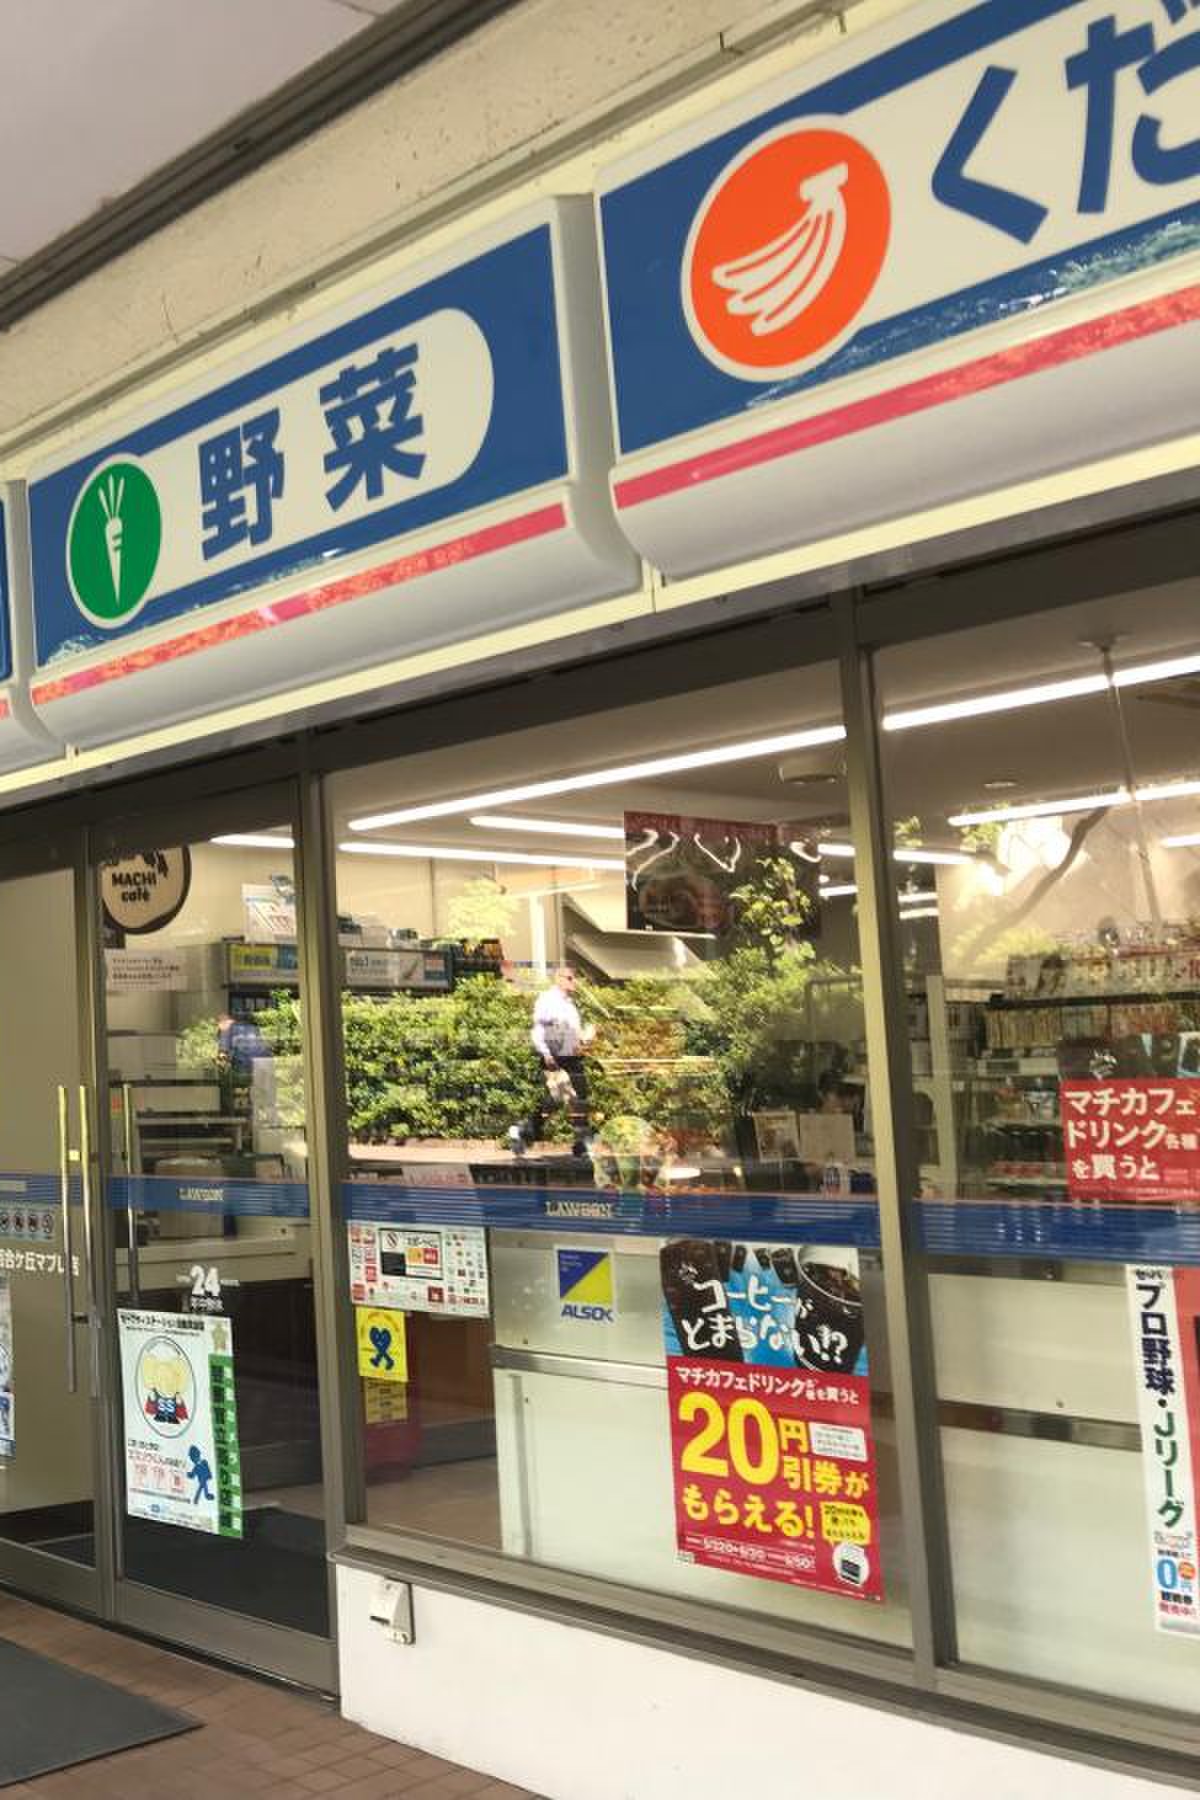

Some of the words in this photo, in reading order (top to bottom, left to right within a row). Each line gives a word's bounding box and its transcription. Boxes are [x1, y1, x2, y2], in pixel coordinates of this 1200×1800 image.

[198, 343, 426, 561] 野菜
[111, 872, 157, 887] MACHI
[1065, 1087, 1197, 1116] マチカフェ
[1071, 1154, 1161, 1180] を買うと
[544, 1201, 613, 1217] LAWSON
[190, 1265, 221, 1297] 24
[693, 1274, 814, 1319] コーヒーが
[560, 1303, 615, 1323] ALSOK
[678, 1391, 780, 1485] 20
[683, 1483, 815, 1539] もらえる!
